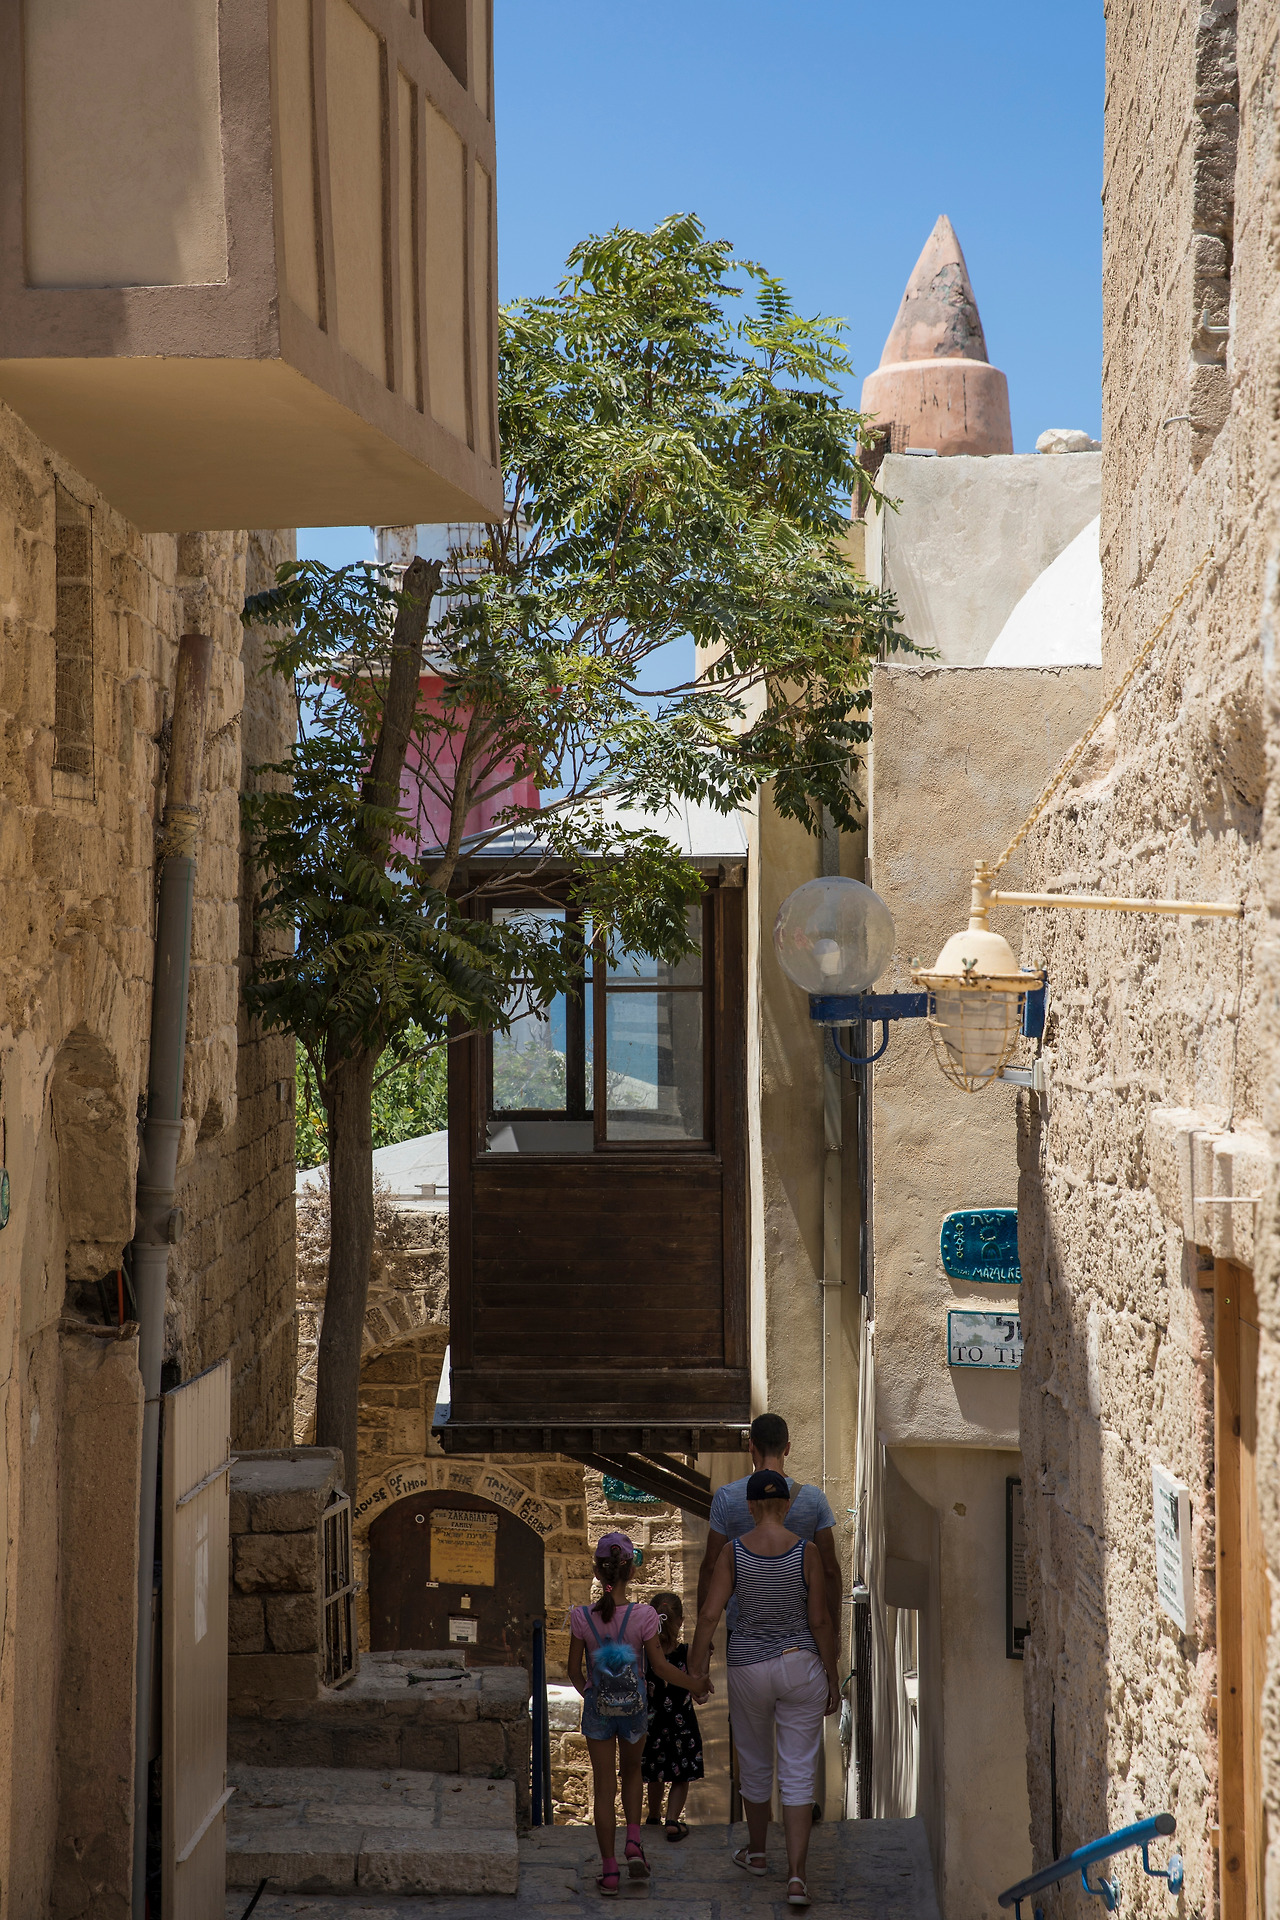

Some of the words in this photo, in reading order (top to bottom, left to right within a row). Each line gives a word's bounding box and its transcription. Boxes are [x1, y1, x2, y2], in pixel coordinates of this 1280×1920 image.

[971, 1266, 1006, 1281] MAZAL
[953, 1346, 983, 1363] TO
[389, 1474, 403, 1486] OF
[449, 1472, 472, 1486] THE
[395, 1479, 427, 1497] SIMON
[353, 1487, 387, 1519] HOUSE
[493, 1491, 516, 1507] DER
